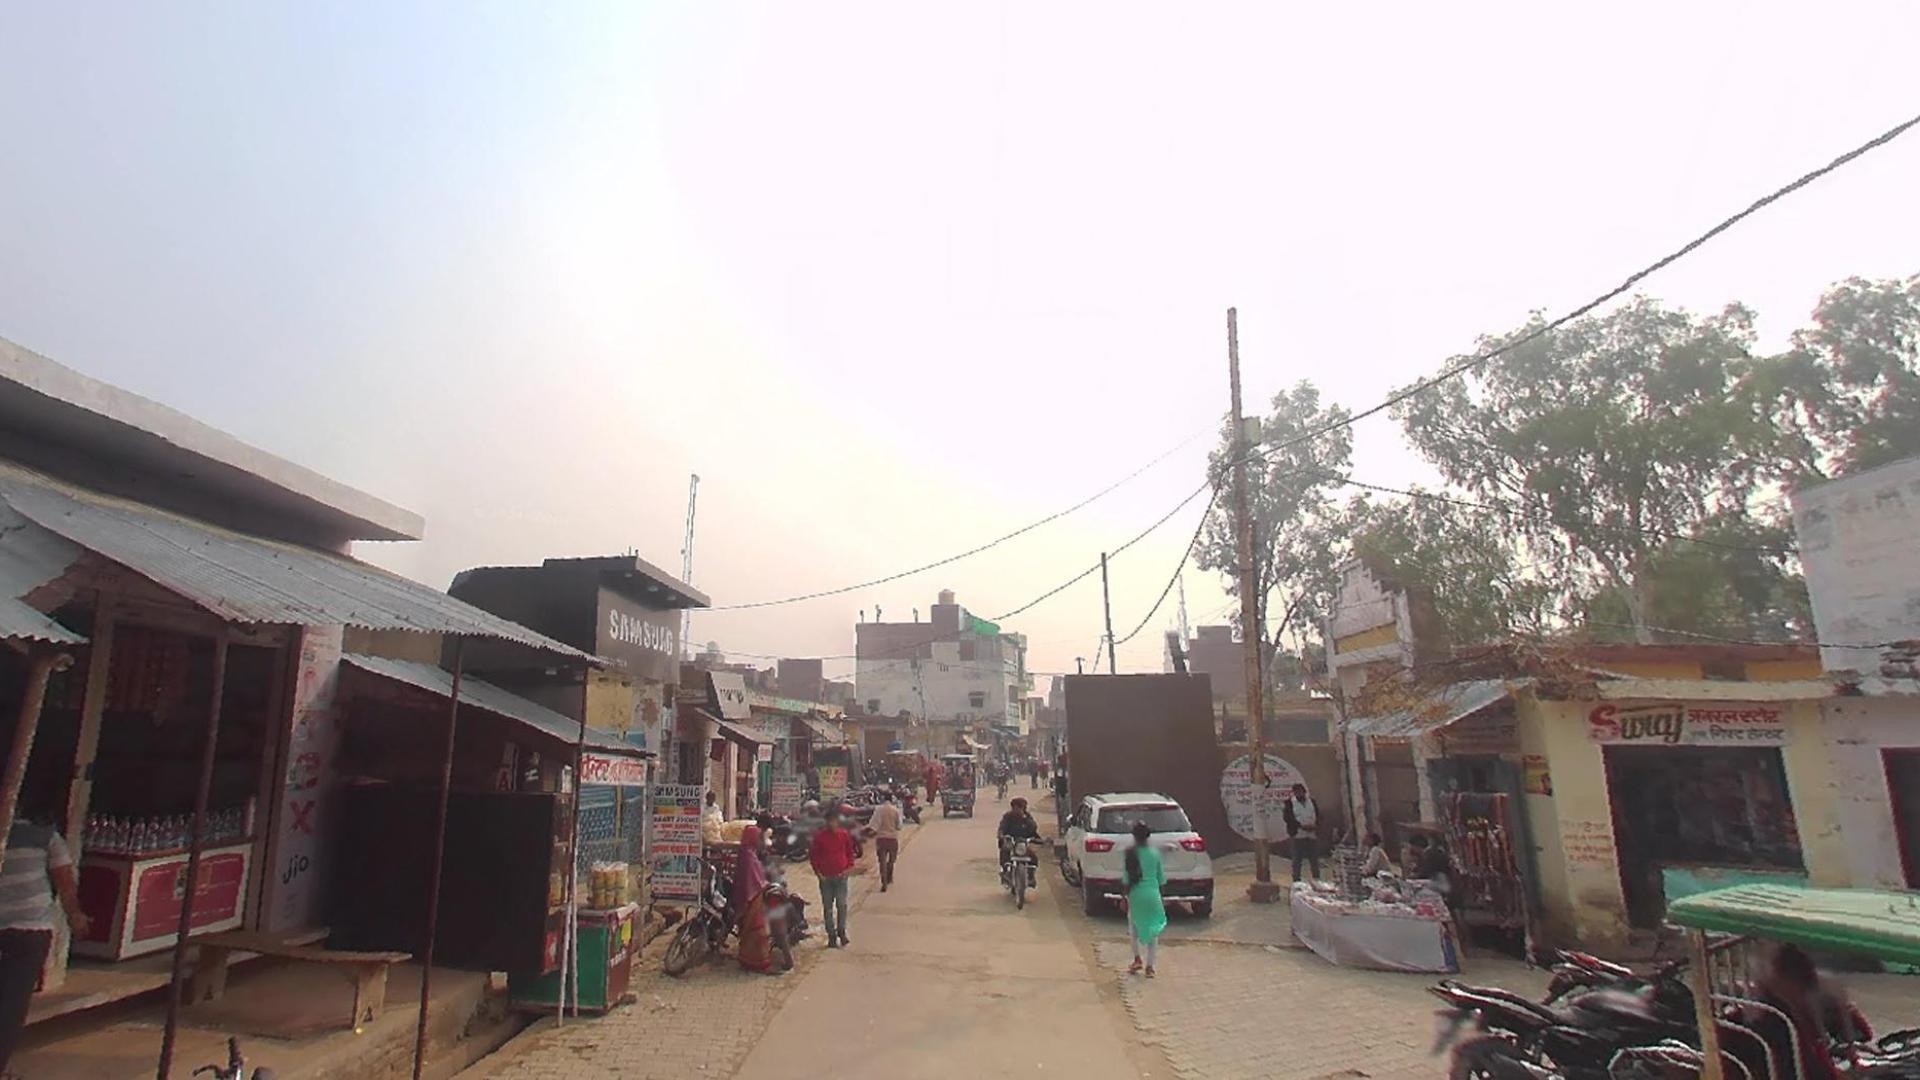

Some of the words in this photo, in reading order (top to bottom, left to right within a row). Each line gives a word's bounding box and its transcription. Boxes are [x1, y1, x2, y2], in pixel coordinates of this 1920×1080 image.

[609, 609, 673, 655] SAMSUNG
[1589, 703, 1683, 743] Sway
[655, 786, 700, 797] SAMSUNG
